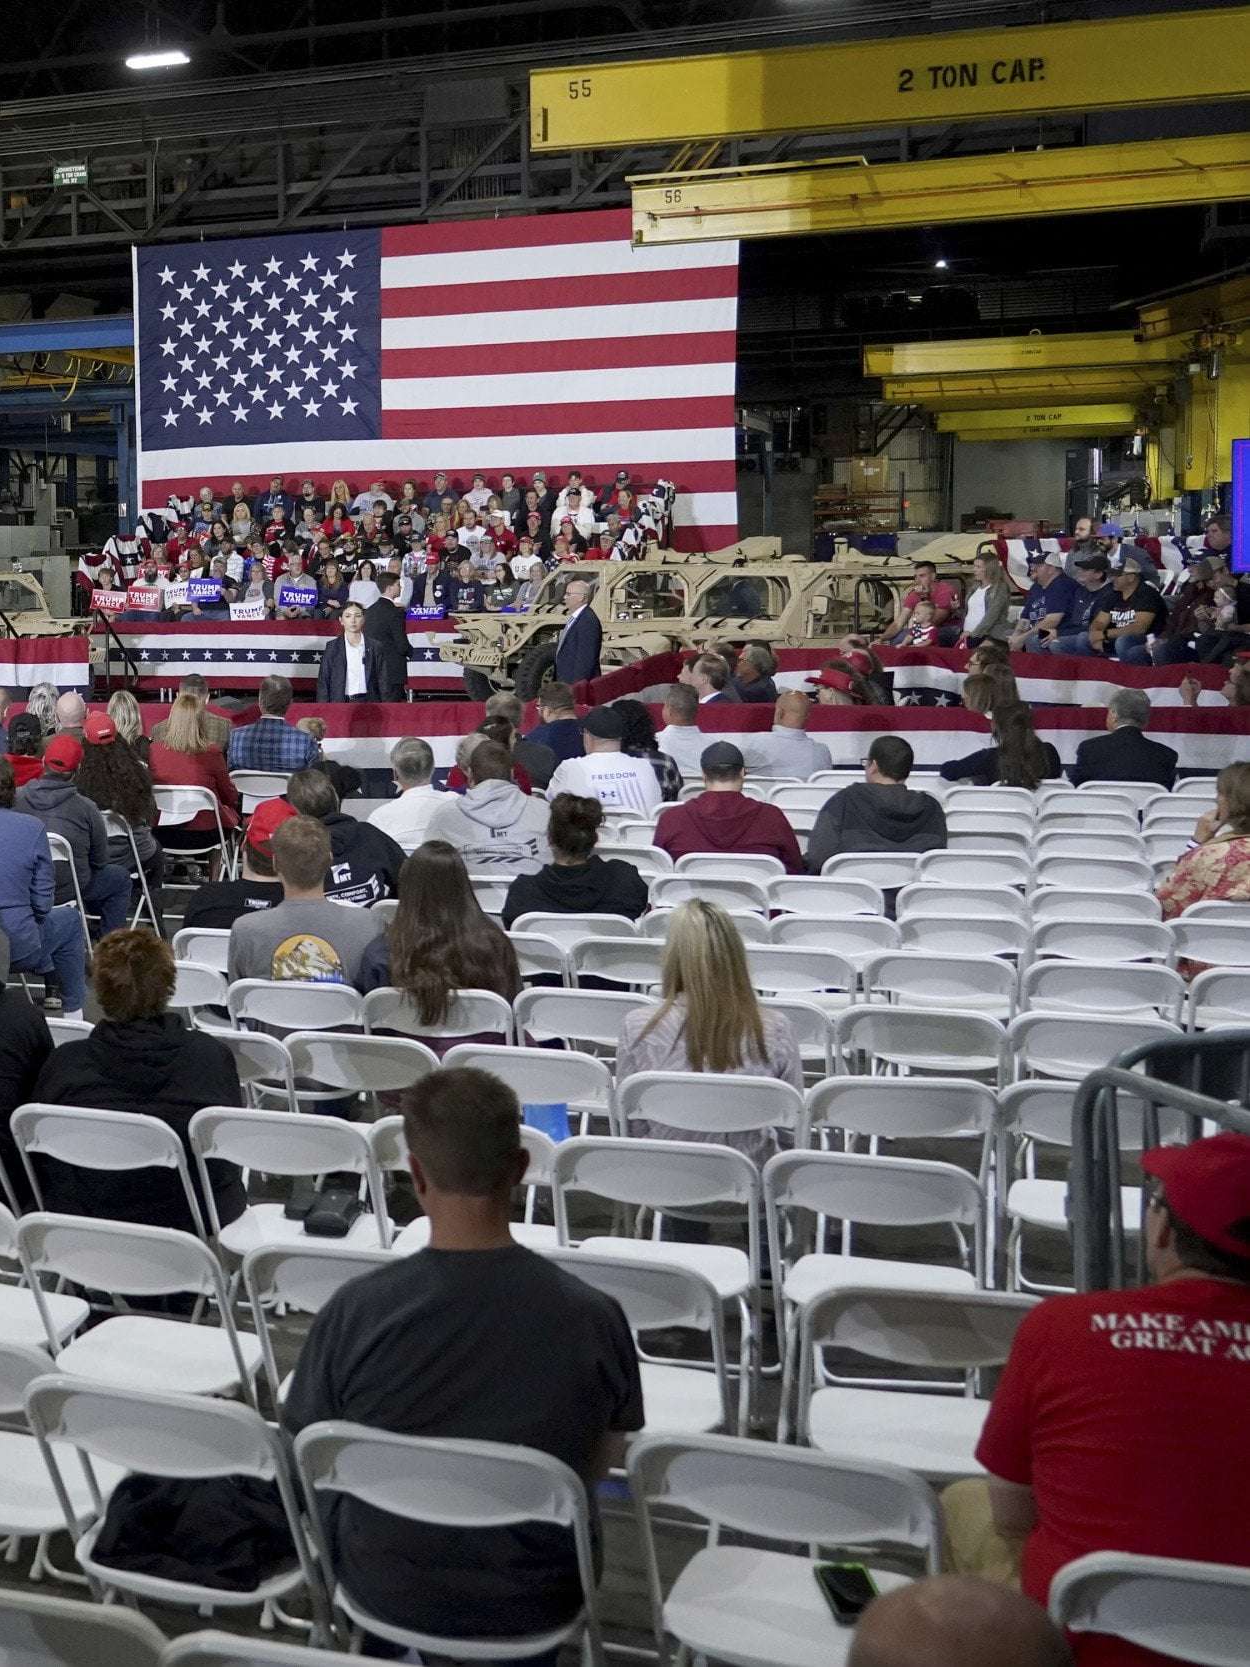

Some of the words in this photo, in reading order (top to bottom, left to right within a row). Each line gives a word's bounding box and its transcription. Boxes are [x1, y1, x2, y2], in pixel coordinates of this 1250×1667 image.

[898, 70, 915, 93] 2
[927, 63, 978, 90] TON
[991, 56, 1046, 85] CAP.
[568, 78, 592, 100] 55
[664, 189, 682, 205] 56
[190, 583, 220, 591] TRUMP
[94, 594, 123, 605] TRUMP
[129, 591, 159, 599] TRUMP
[282, 590, 315, 600] TRUMP
[232, 606, 263, 616] TRUMP
[1109, 609, 1136, 621] TRUMP
[591, 771, 637, 780] FREEDOM
[1090, 1312, 1186, 1332] MAKE
[1110, 1331, 1218, 1356] GREAT
